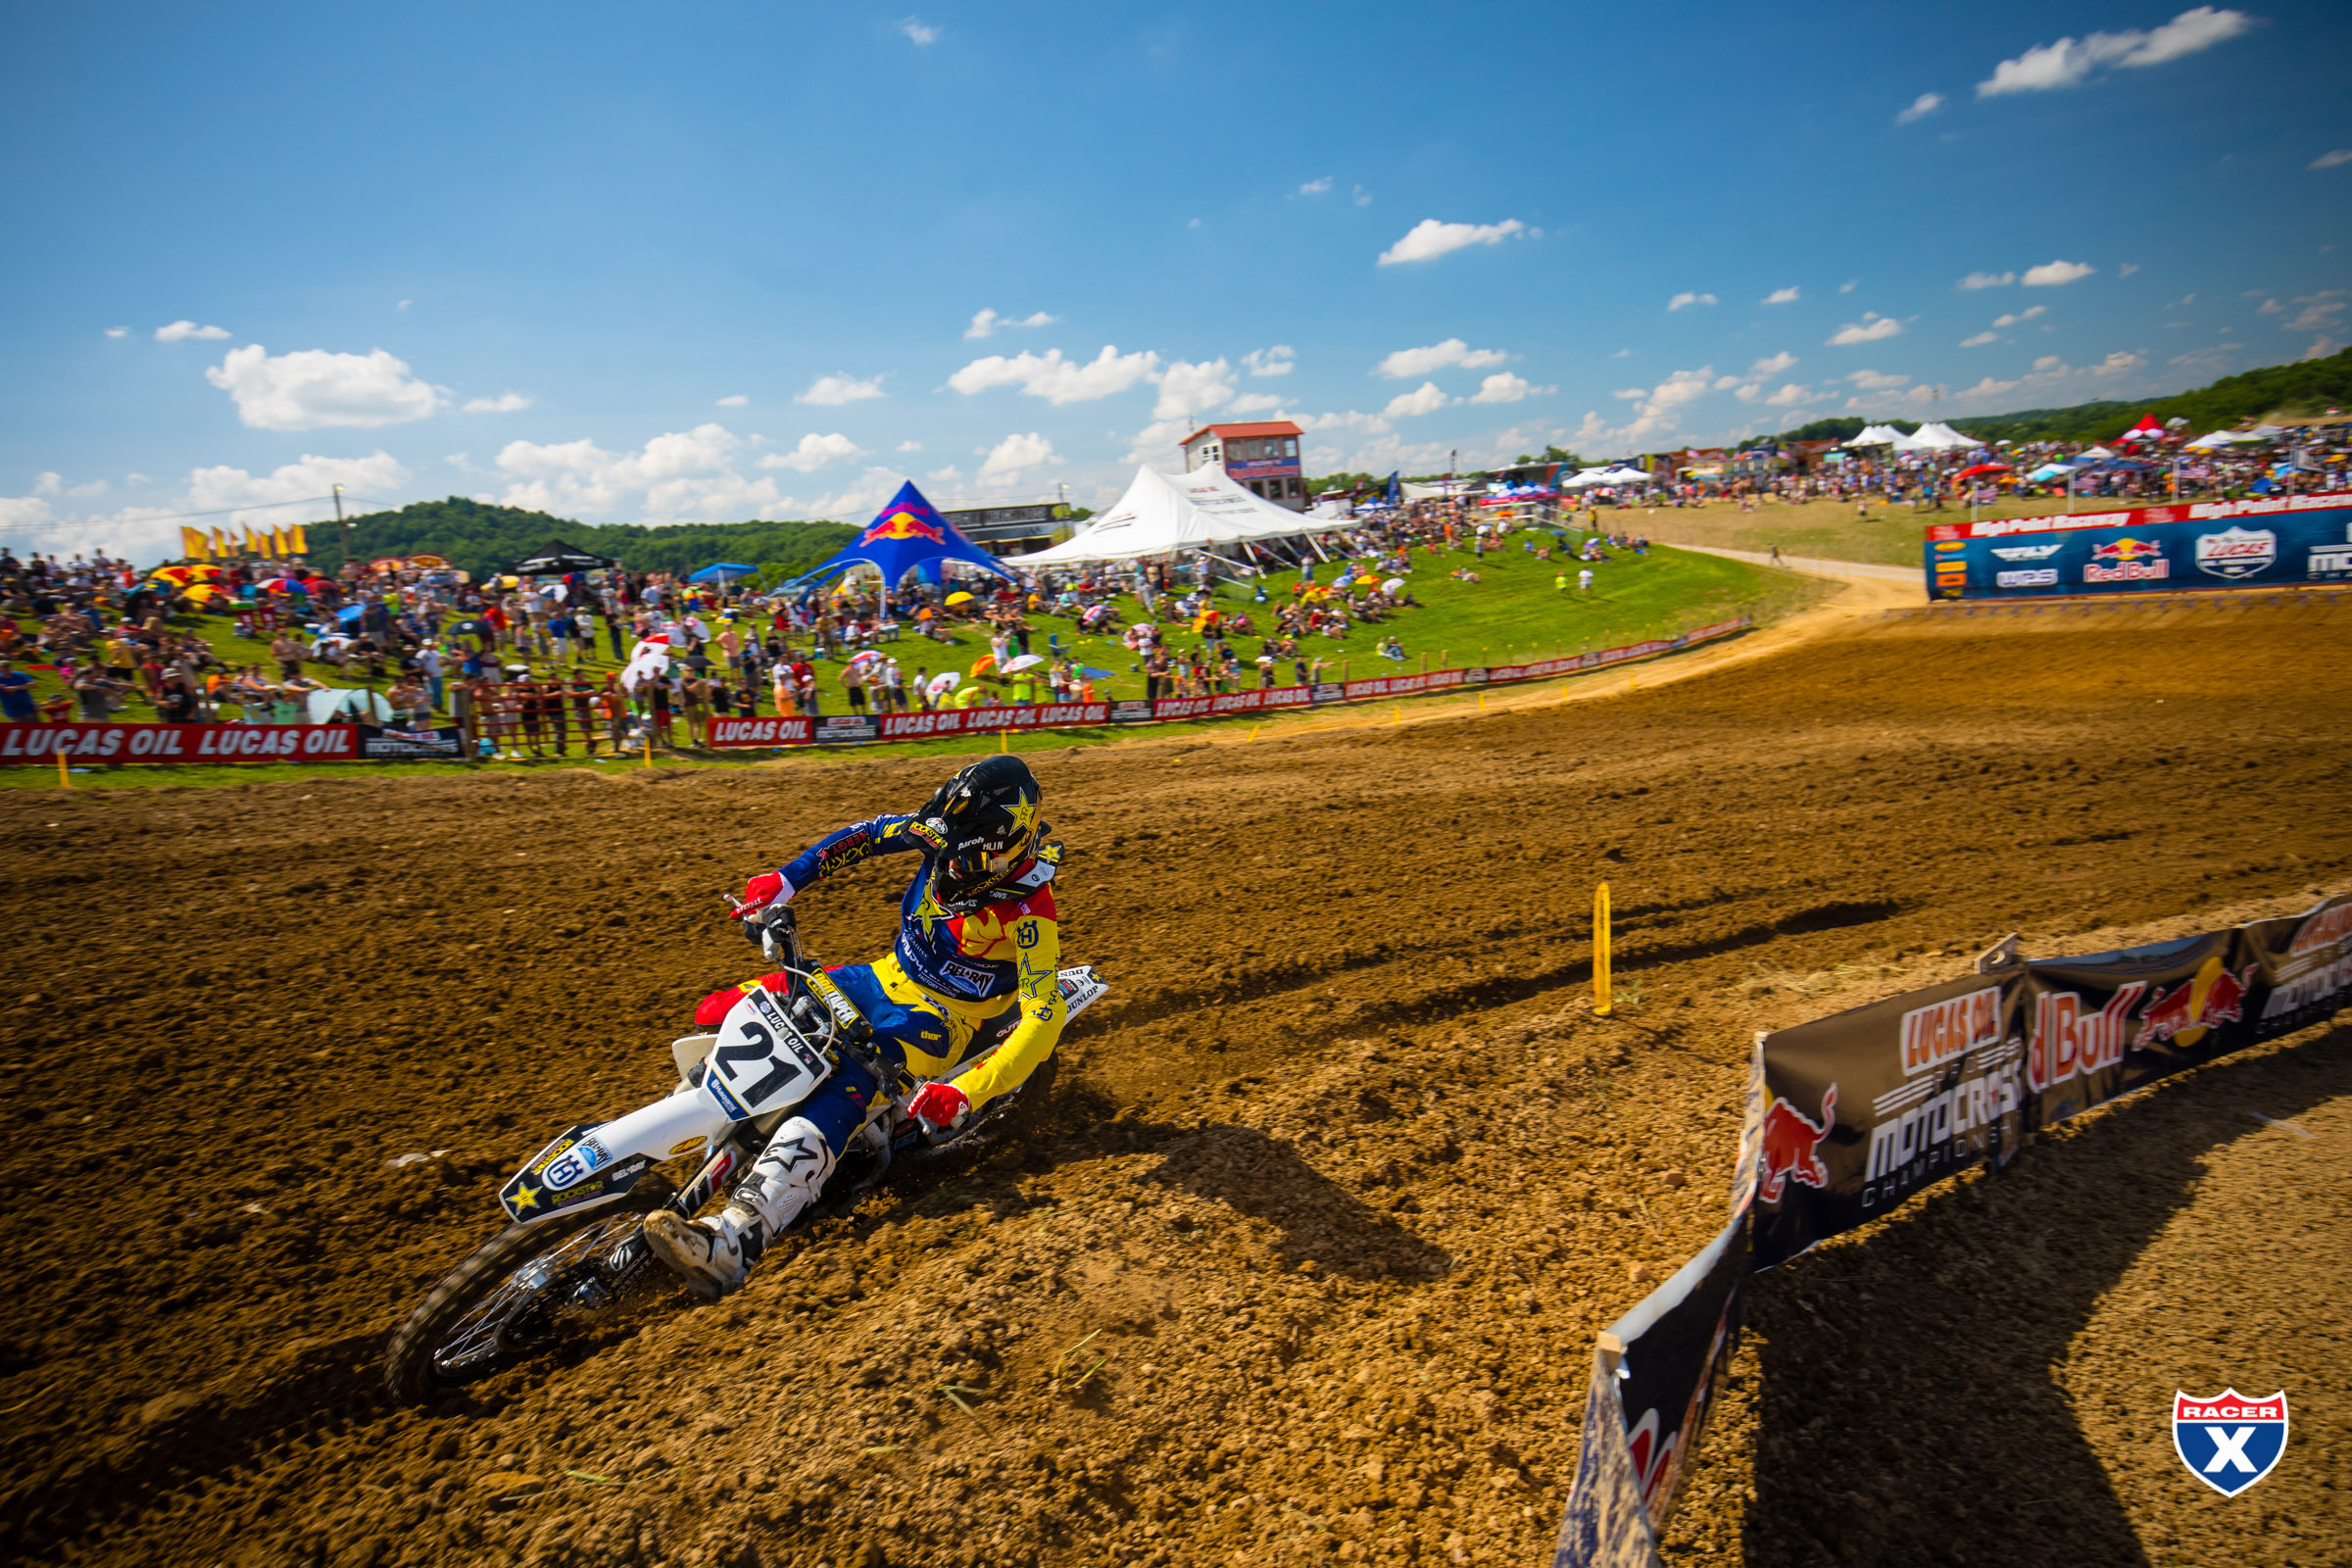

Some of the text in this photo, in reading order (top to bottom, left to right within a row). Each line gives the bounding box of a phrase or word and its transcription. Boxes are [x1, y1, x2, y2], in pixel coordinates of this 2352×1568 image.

[2083, 559, 2170, 583] Red Bull
[883, 712, 961, 736] LUCAS OIL
[965, 708, 1037, 728] LUCAS OIL
[1040, 706, 1083, 723] LUCAS
[1083, 705, 1106, 721] OIL
[2, 728, 184, 758] LUCAS OIL
[198, 728, 352, 756] LUCAS OIL
[714, 720, 808, 742] LUCAS OIL
[909, 821, 948, 850] ROCKSTAR
[957, 836, 985, 851] Airoh
[917, 973, 939, 990] FACTORY
[1067, 985, 1099, 1014] DUNLOP
[920, 1030, 942, 1042] thor
[1907, 997, 1968, 1069] LUCAS
[1973, 990, 1997, 1044] OIL
[2052, 980, 2148, 1086] Bull
[787, 1038, 805, 1054] OIL
[714, 1021, 803, 1108] 21
[551, 1180, 605, 1205] ROCKSTAR
